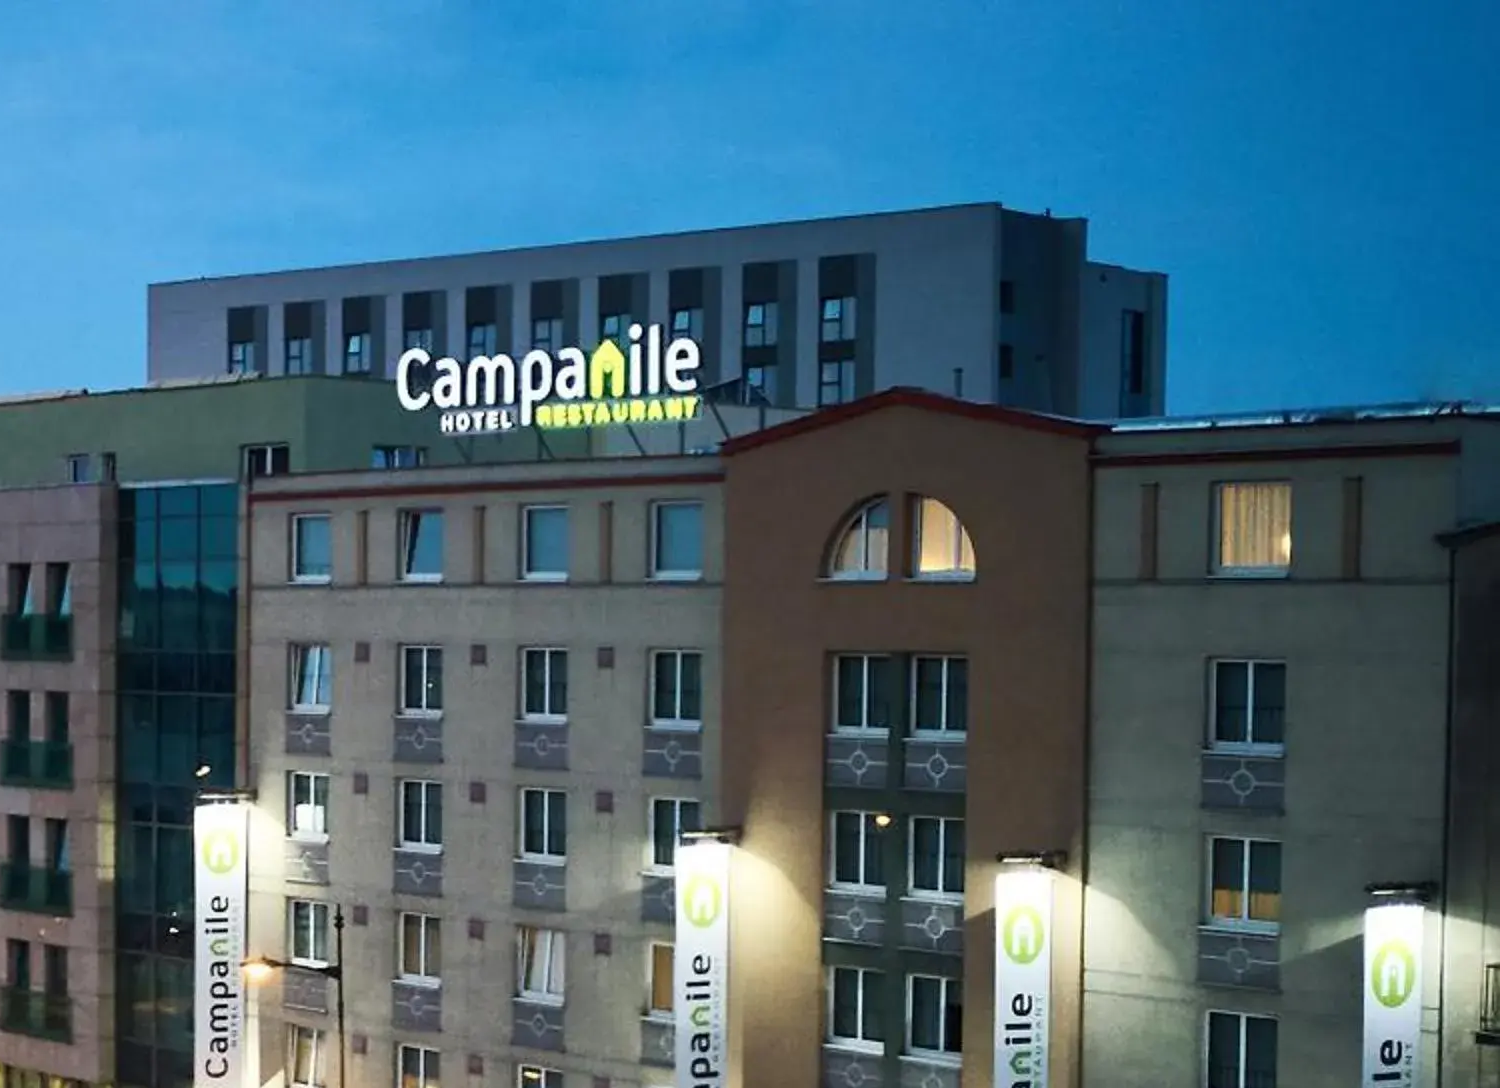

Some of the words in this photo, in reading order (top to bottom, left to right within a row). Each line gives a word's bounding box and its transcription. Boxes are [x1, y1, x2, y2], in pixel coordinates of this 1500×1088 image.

[396, 323, 700, 426] Campanile
[441, 410, 513, 432] HOTEL
[535, 397, 699, 427] RESTAURANT
[205, 895, 238, 1079] Campanile
